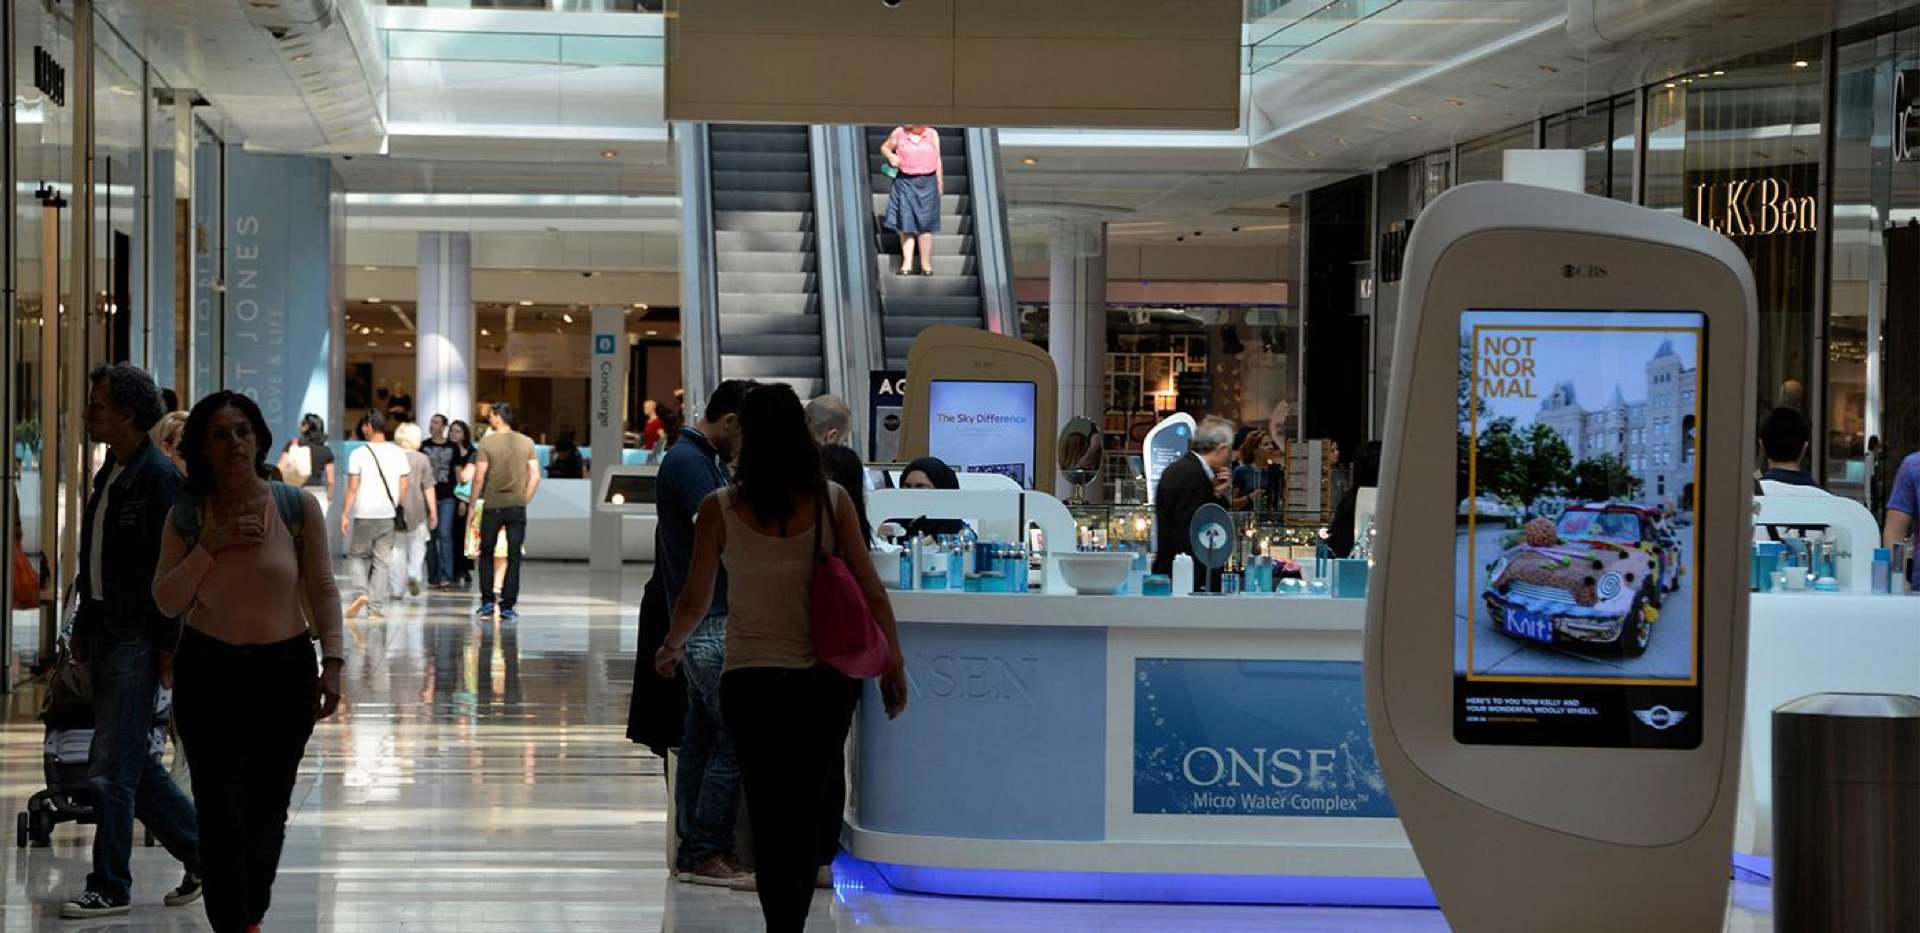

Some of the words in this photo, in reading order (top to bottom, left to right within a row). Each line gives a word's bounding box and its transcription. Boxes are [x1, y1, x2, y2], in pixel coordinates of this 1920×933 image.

[236, 215, 259, 342] JONES
[267, 308, 284, 345] LIFE
[1484, 336, 1537, 356] NOT
[1484, 357, 1537, 378] NOR
[597, 361, 612, 428] Concierge
[1484, 378, 1537, 398] MAL
[267, 374, 283, 425] LOVE
[938, 413, 956, 424] The
[957, 413, 974, 426] Sky
[976, 412, 1027, 424] Difference
[875, 652, 1039, 702] NSEN
[1562, 699, 1580, 707] AND
[1193, 791, 1236, 810] Micro
[1241, 793, 1286, 811] Water
